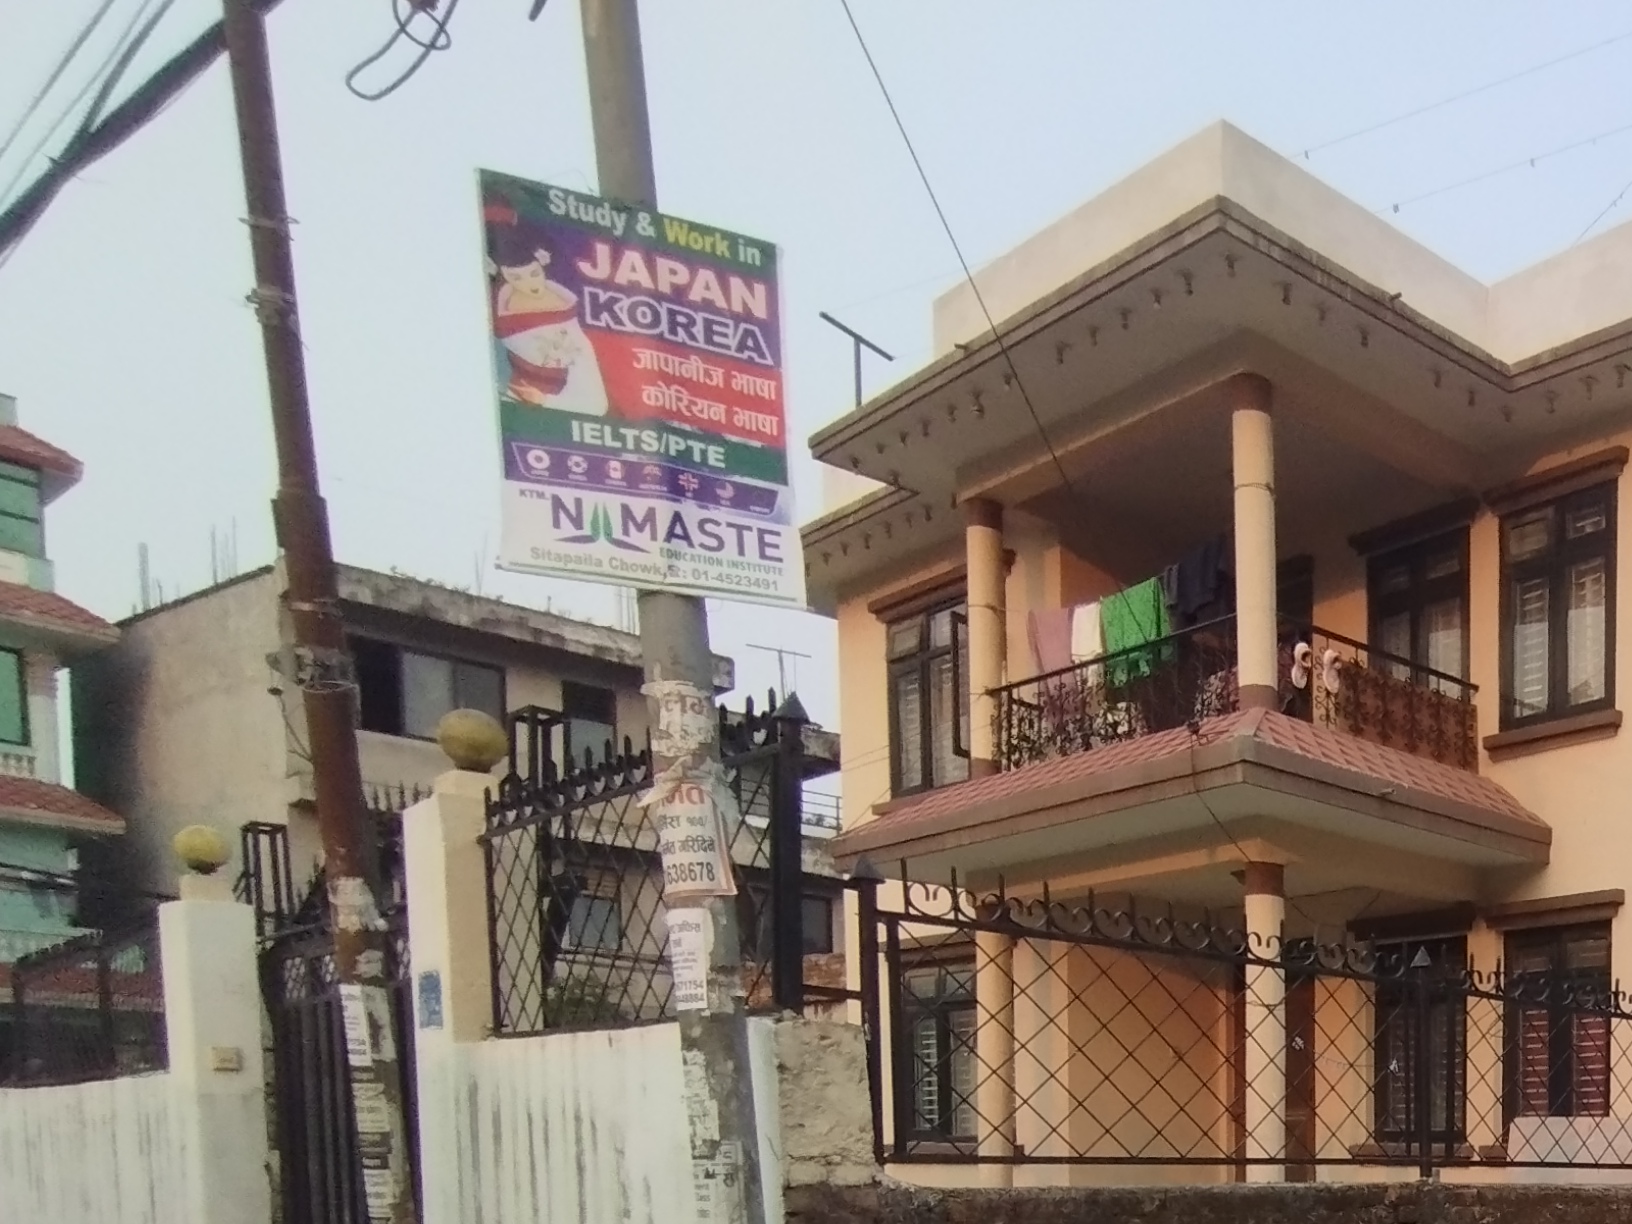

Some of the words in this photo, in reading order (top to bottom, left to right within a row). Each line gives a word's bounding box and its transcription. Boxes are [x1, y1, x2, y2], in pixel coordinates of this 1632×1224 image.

[549, 189, 627, 236] Study
[636, 211, 655, 238] &
[663, 217, 731, 258] Work
[737, 238, 761, 266] in
[578, 242, 767, 320] JAPAN
[583, 287, 774, 366] KOREA
[632, 348, 725, 389] जापानीज
[731, 370, 777, 400] भाषा
[642, 381, 726, 425] कोरियन
[733, 407, 779, 436] भाषा
[572, 420, 725, 468] IELTS/PTE
[530, 547, 603, 567] Sitapaila
[659, 547, 723, 568] EDUCATION
[727, 559, 783, 576] INSTITUTE
